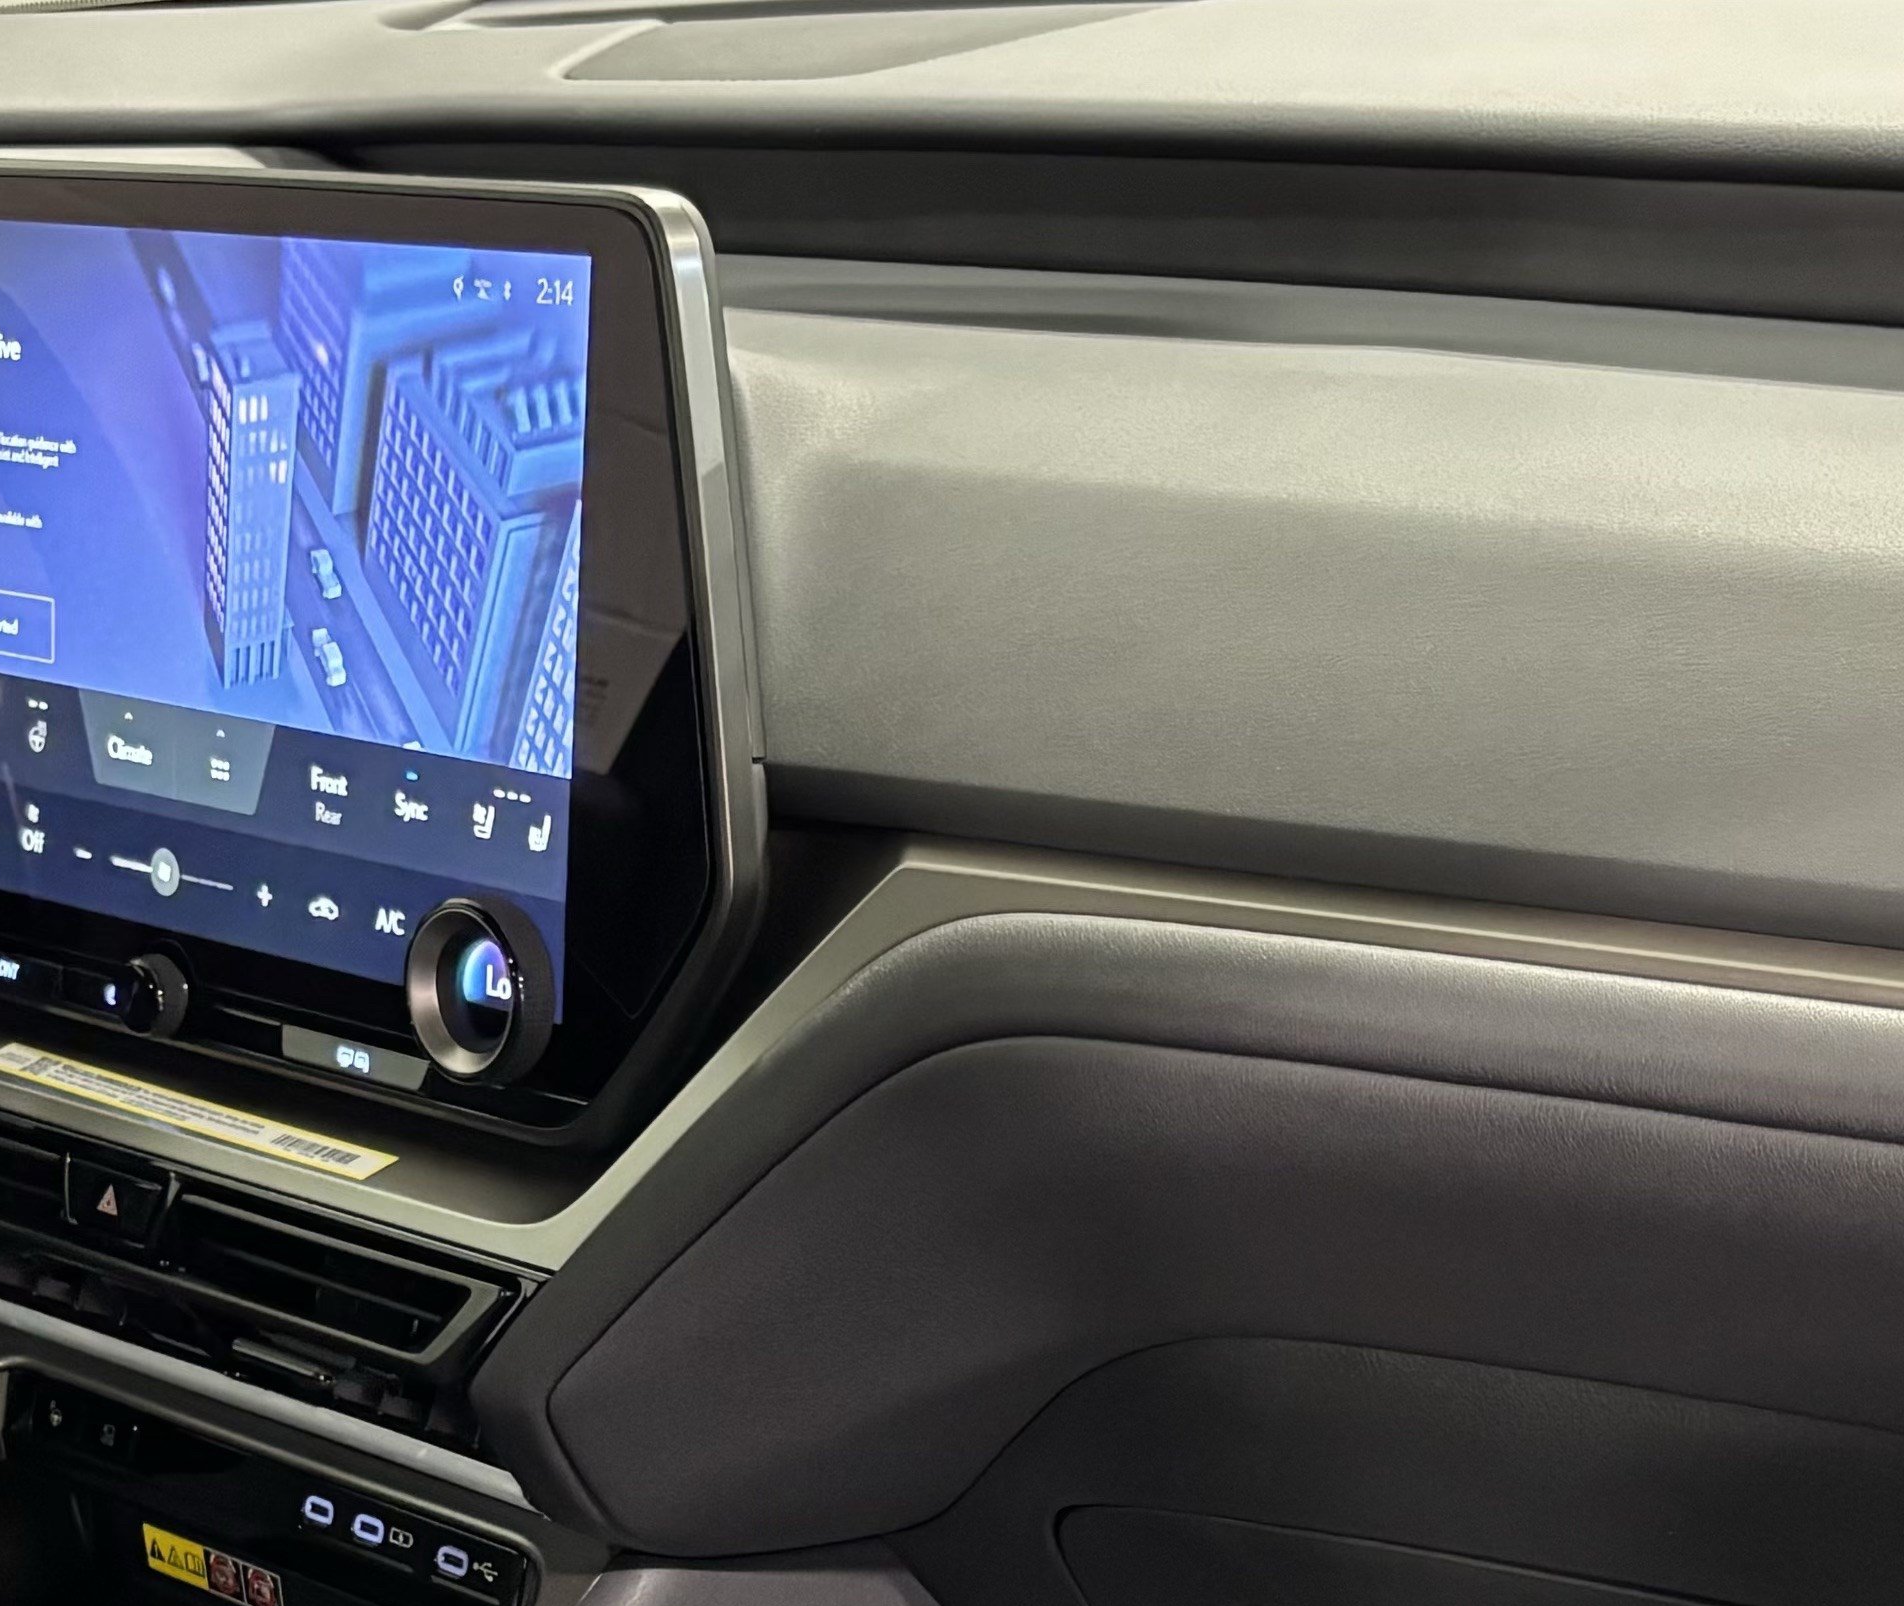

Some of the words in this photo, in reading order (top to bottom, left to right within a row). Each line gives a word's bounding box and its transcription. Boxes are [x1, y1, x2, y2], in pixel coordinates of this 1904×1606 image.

[536, 278, 573, 306] 2:14
[107, 734, 153, 766] Climate
[310, 763, 348, 796] Front
[395, 790, 429, 822] Sync
[315, 801, 342, 825] Rear
[21, 827, 45, 854] Off
[375, 907, 406, 936] A/C
[486, 964, 511, 1000] Lo
